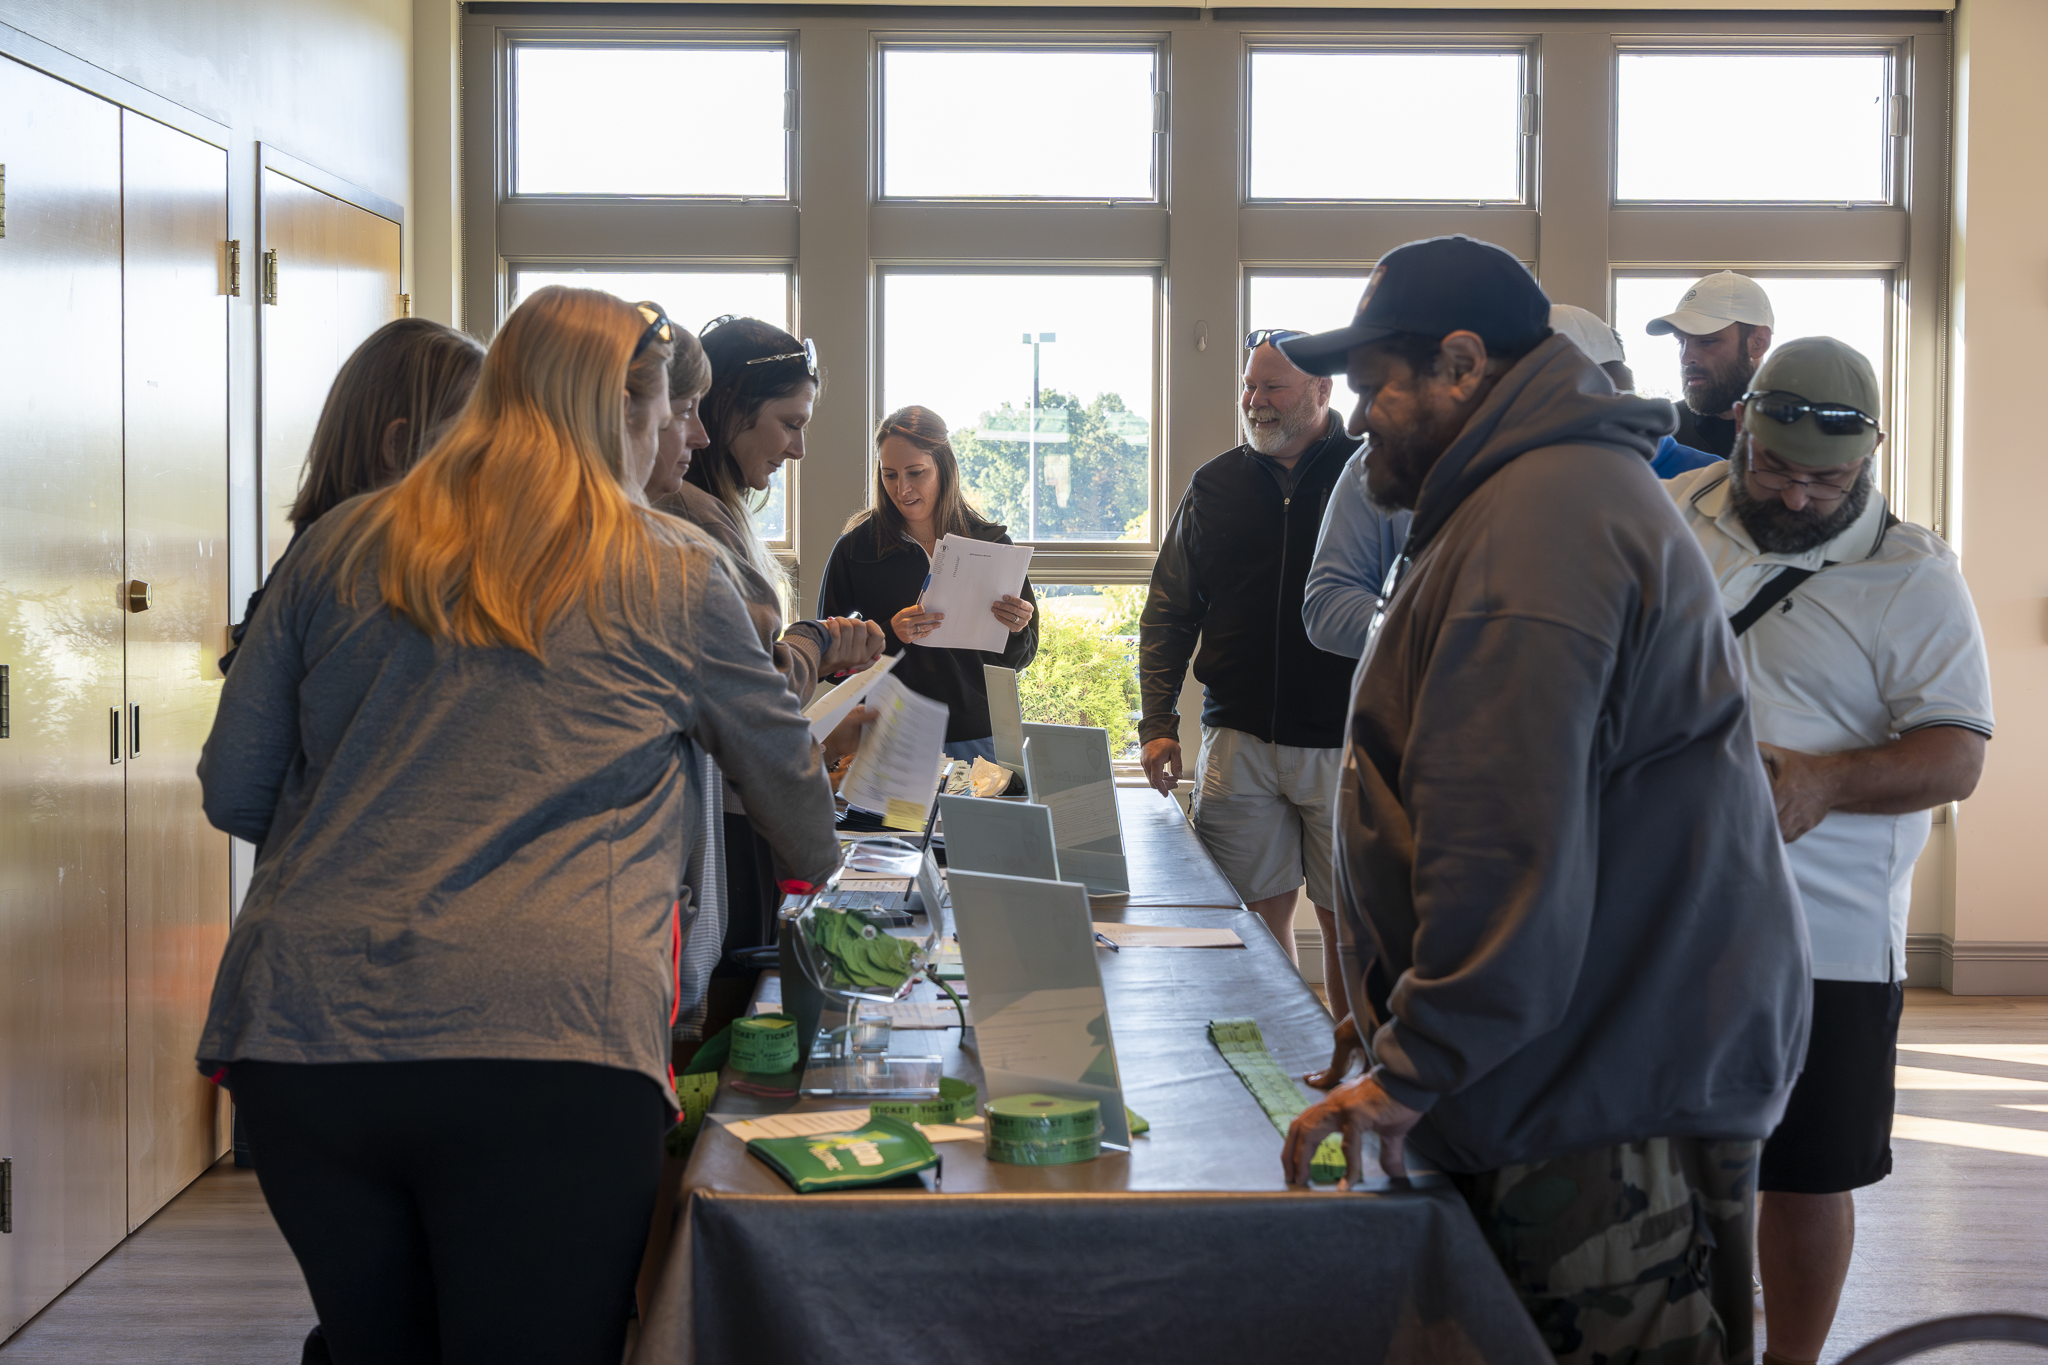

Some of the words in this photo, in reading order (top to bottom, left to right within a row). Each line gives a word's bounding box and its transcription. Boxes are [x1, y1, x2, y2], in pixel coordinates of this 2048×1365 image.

[765, 1029, 794, 1041] TICKET
[874, 1106, 912, 1114] TICKET
[922, 1104, 954, 1113] TICKET
